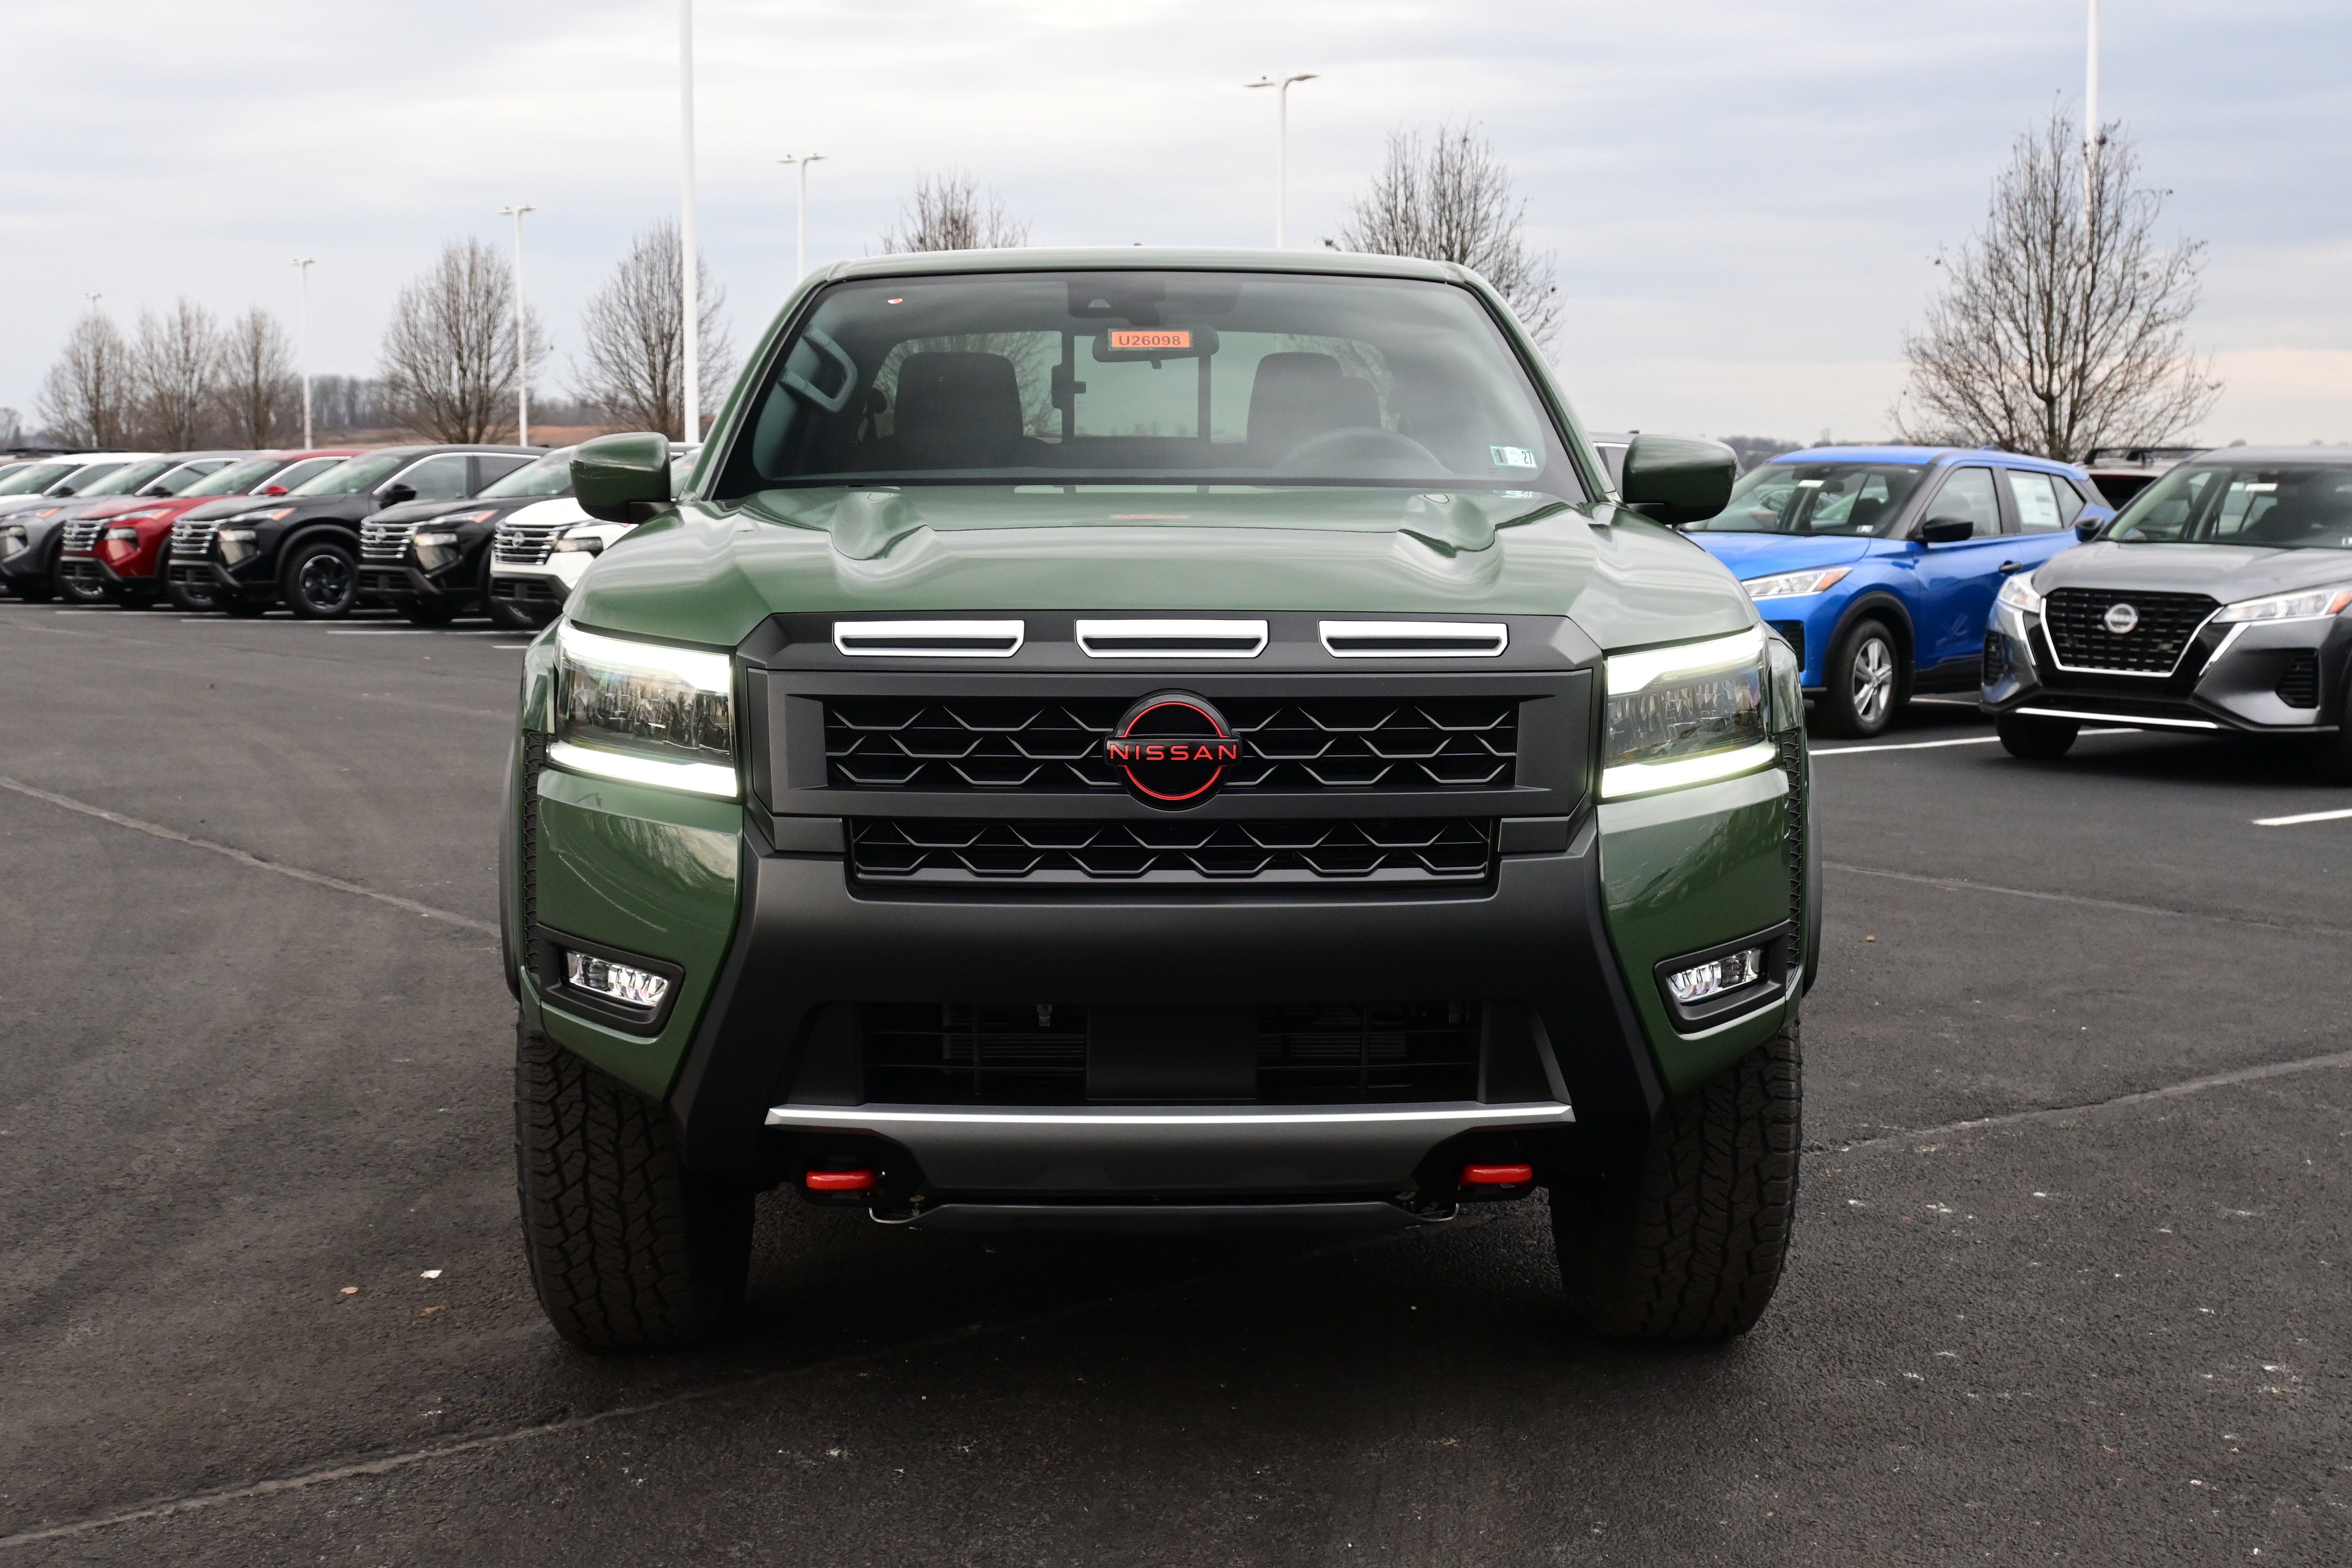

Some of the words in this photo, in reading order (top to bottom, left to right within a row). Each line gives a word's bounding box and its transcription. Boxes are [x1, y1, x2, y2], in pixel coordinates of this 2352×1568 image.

[1119, 335, 1181, 346] U26098
[1496, 449, 1504, 463] 1
[1522, 451, 1533, 464] 27
[1110, 744, 1237, 760] NISSAN
